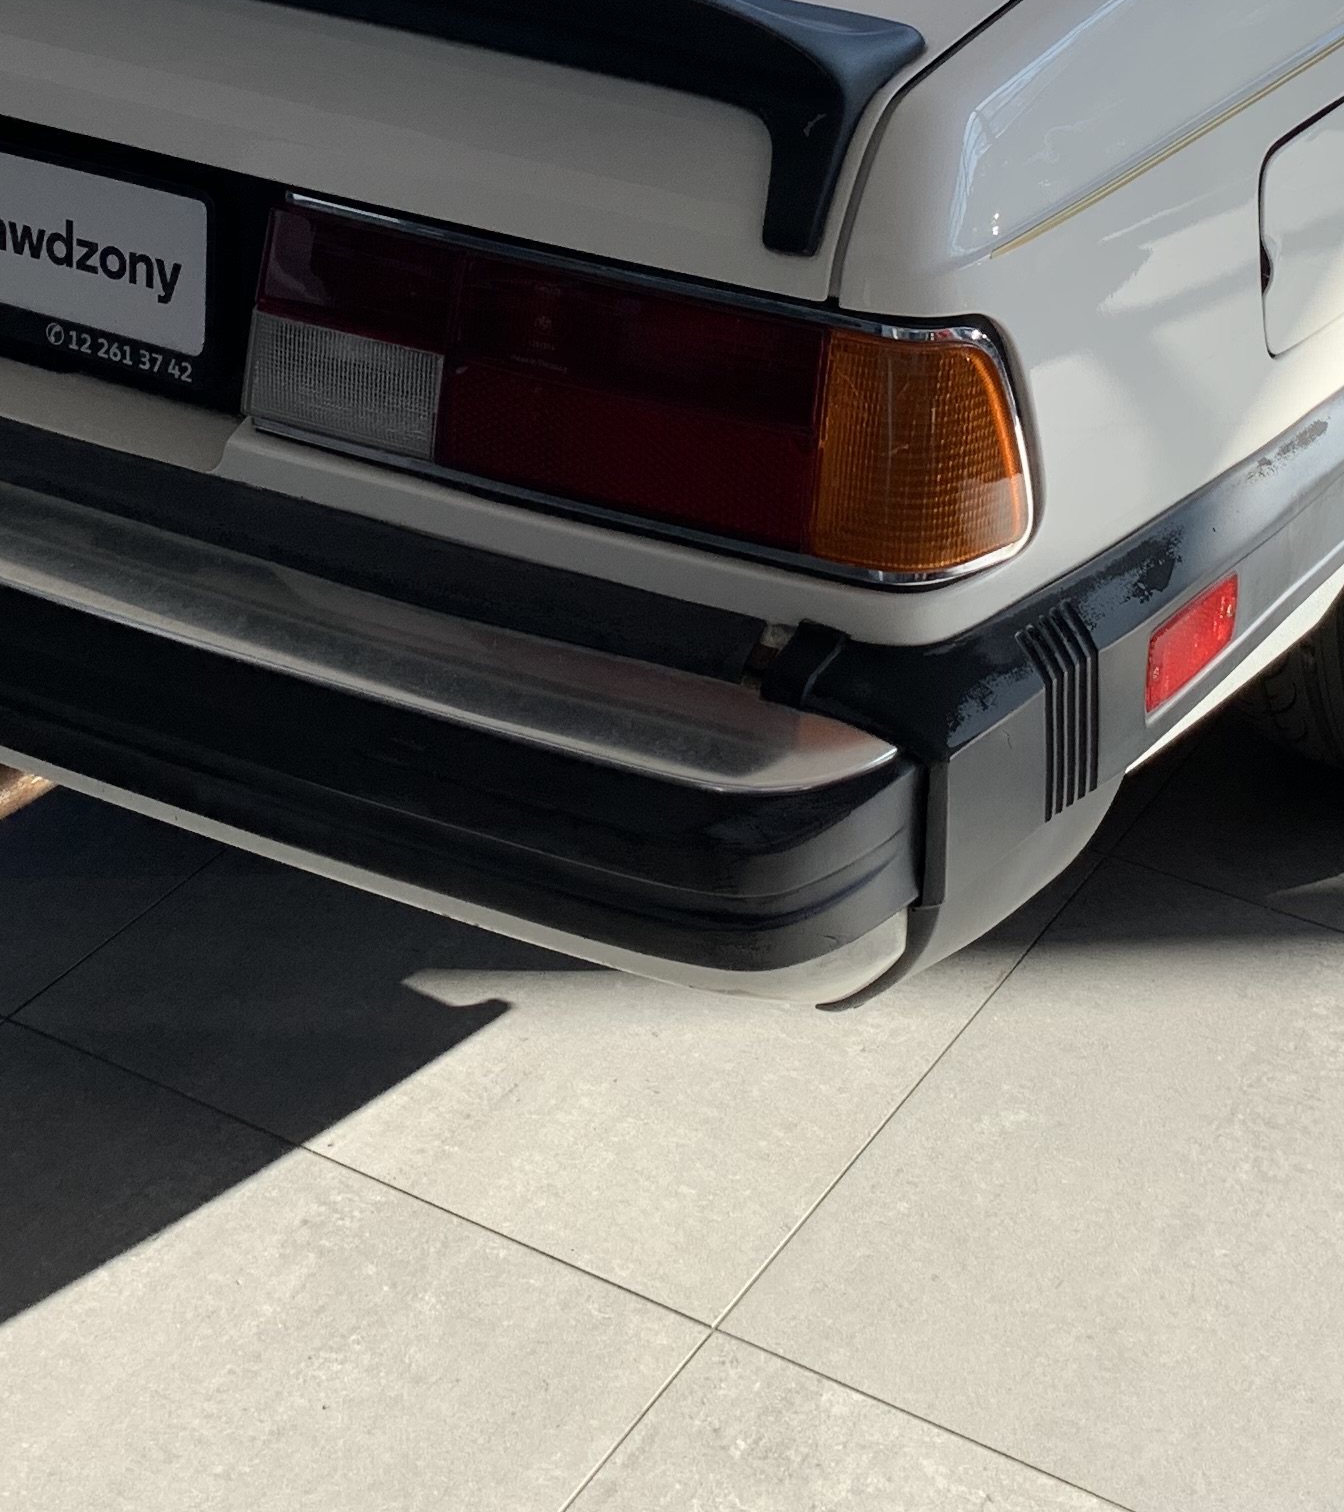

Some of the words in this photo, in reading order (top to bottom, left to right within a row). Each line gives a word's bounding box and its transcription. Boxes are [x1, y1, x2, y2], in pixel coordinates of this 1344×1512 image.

[68, 330, 92, 354] 12
[97, 338, 133, 366] 261
[138, 349, 163, 373] 37
[167, 359, 193, 383] 42
